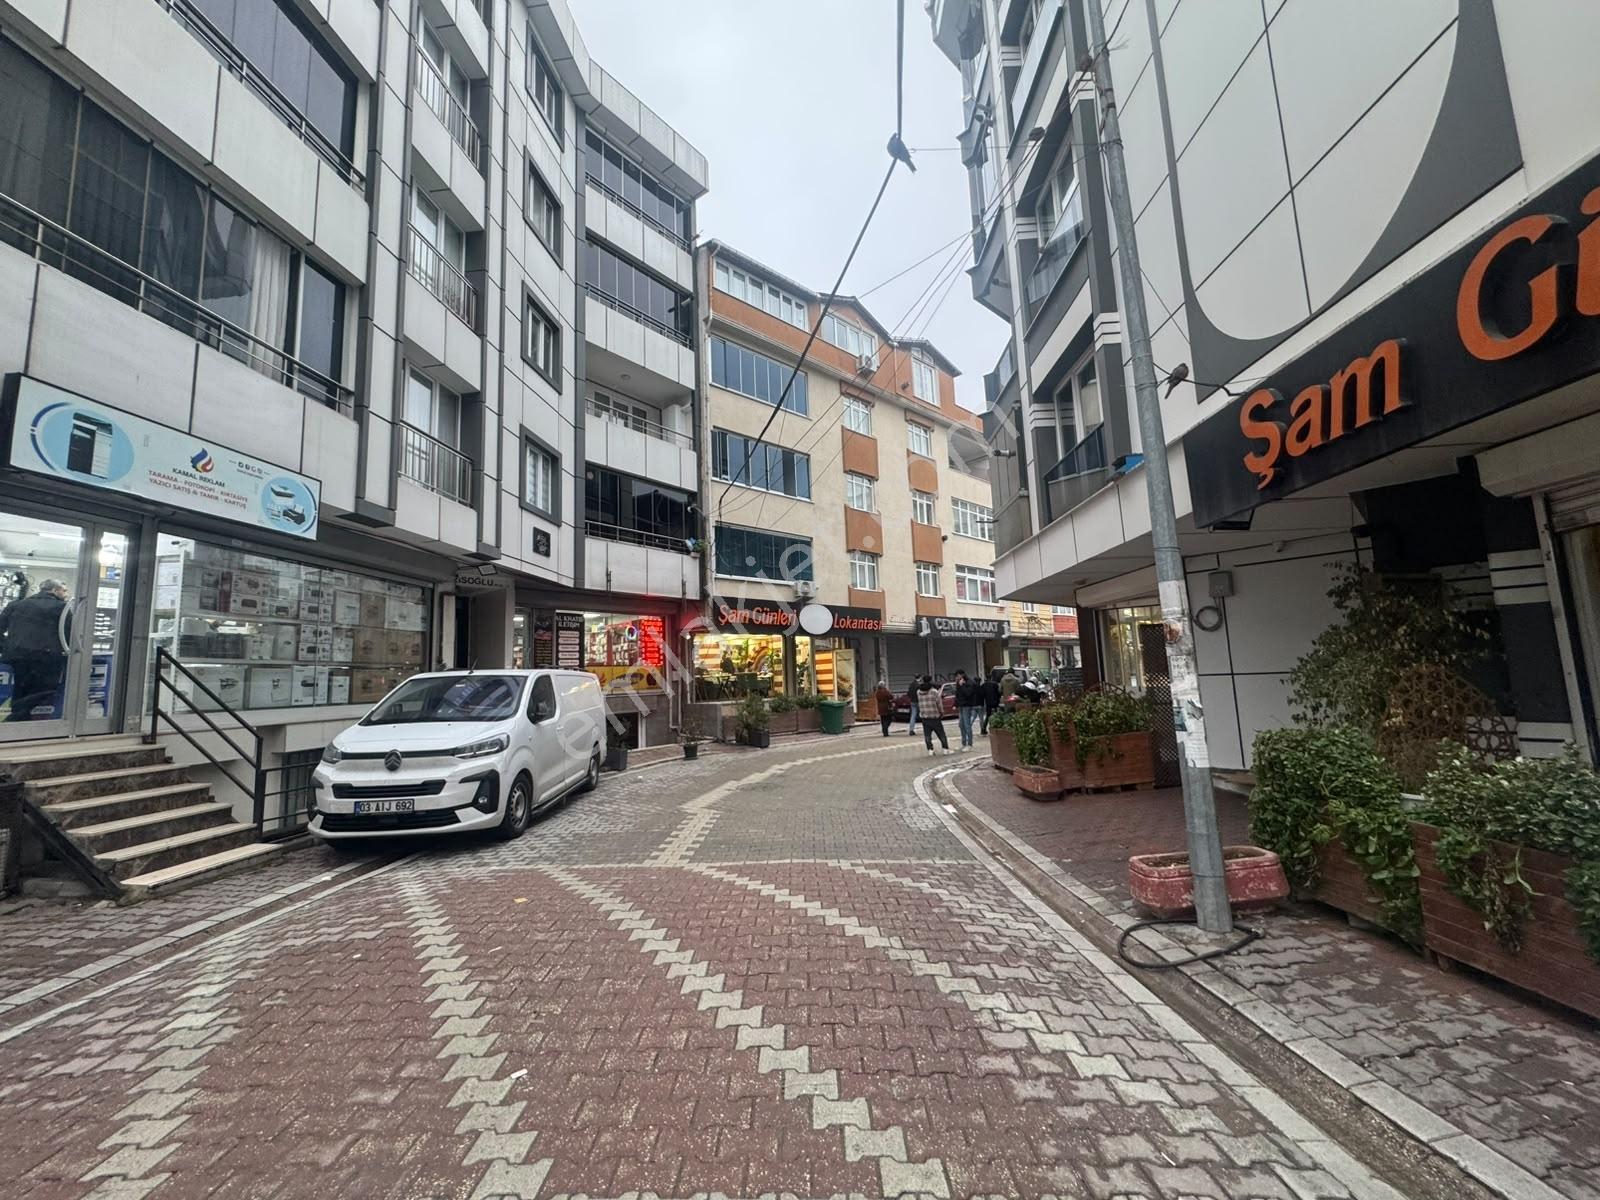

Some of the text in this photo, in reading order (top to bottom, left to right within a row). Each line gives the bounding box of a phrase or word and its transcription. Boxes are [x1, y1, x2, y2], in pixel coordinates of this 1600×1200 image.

[1239, 339, 1401, 490] Şam
[148, 470, 179, 482] TARAMA
[173, 468, 226, 488] KAMAL REKLAM
[172, 484, 191, 495] SATIŞ
[224, 498, 247, 510] KARTUŞ
[718, 604, 883, 632] Şam Günleri Lokantası
[359, 800, 412, 812] 03 AIJ 692
